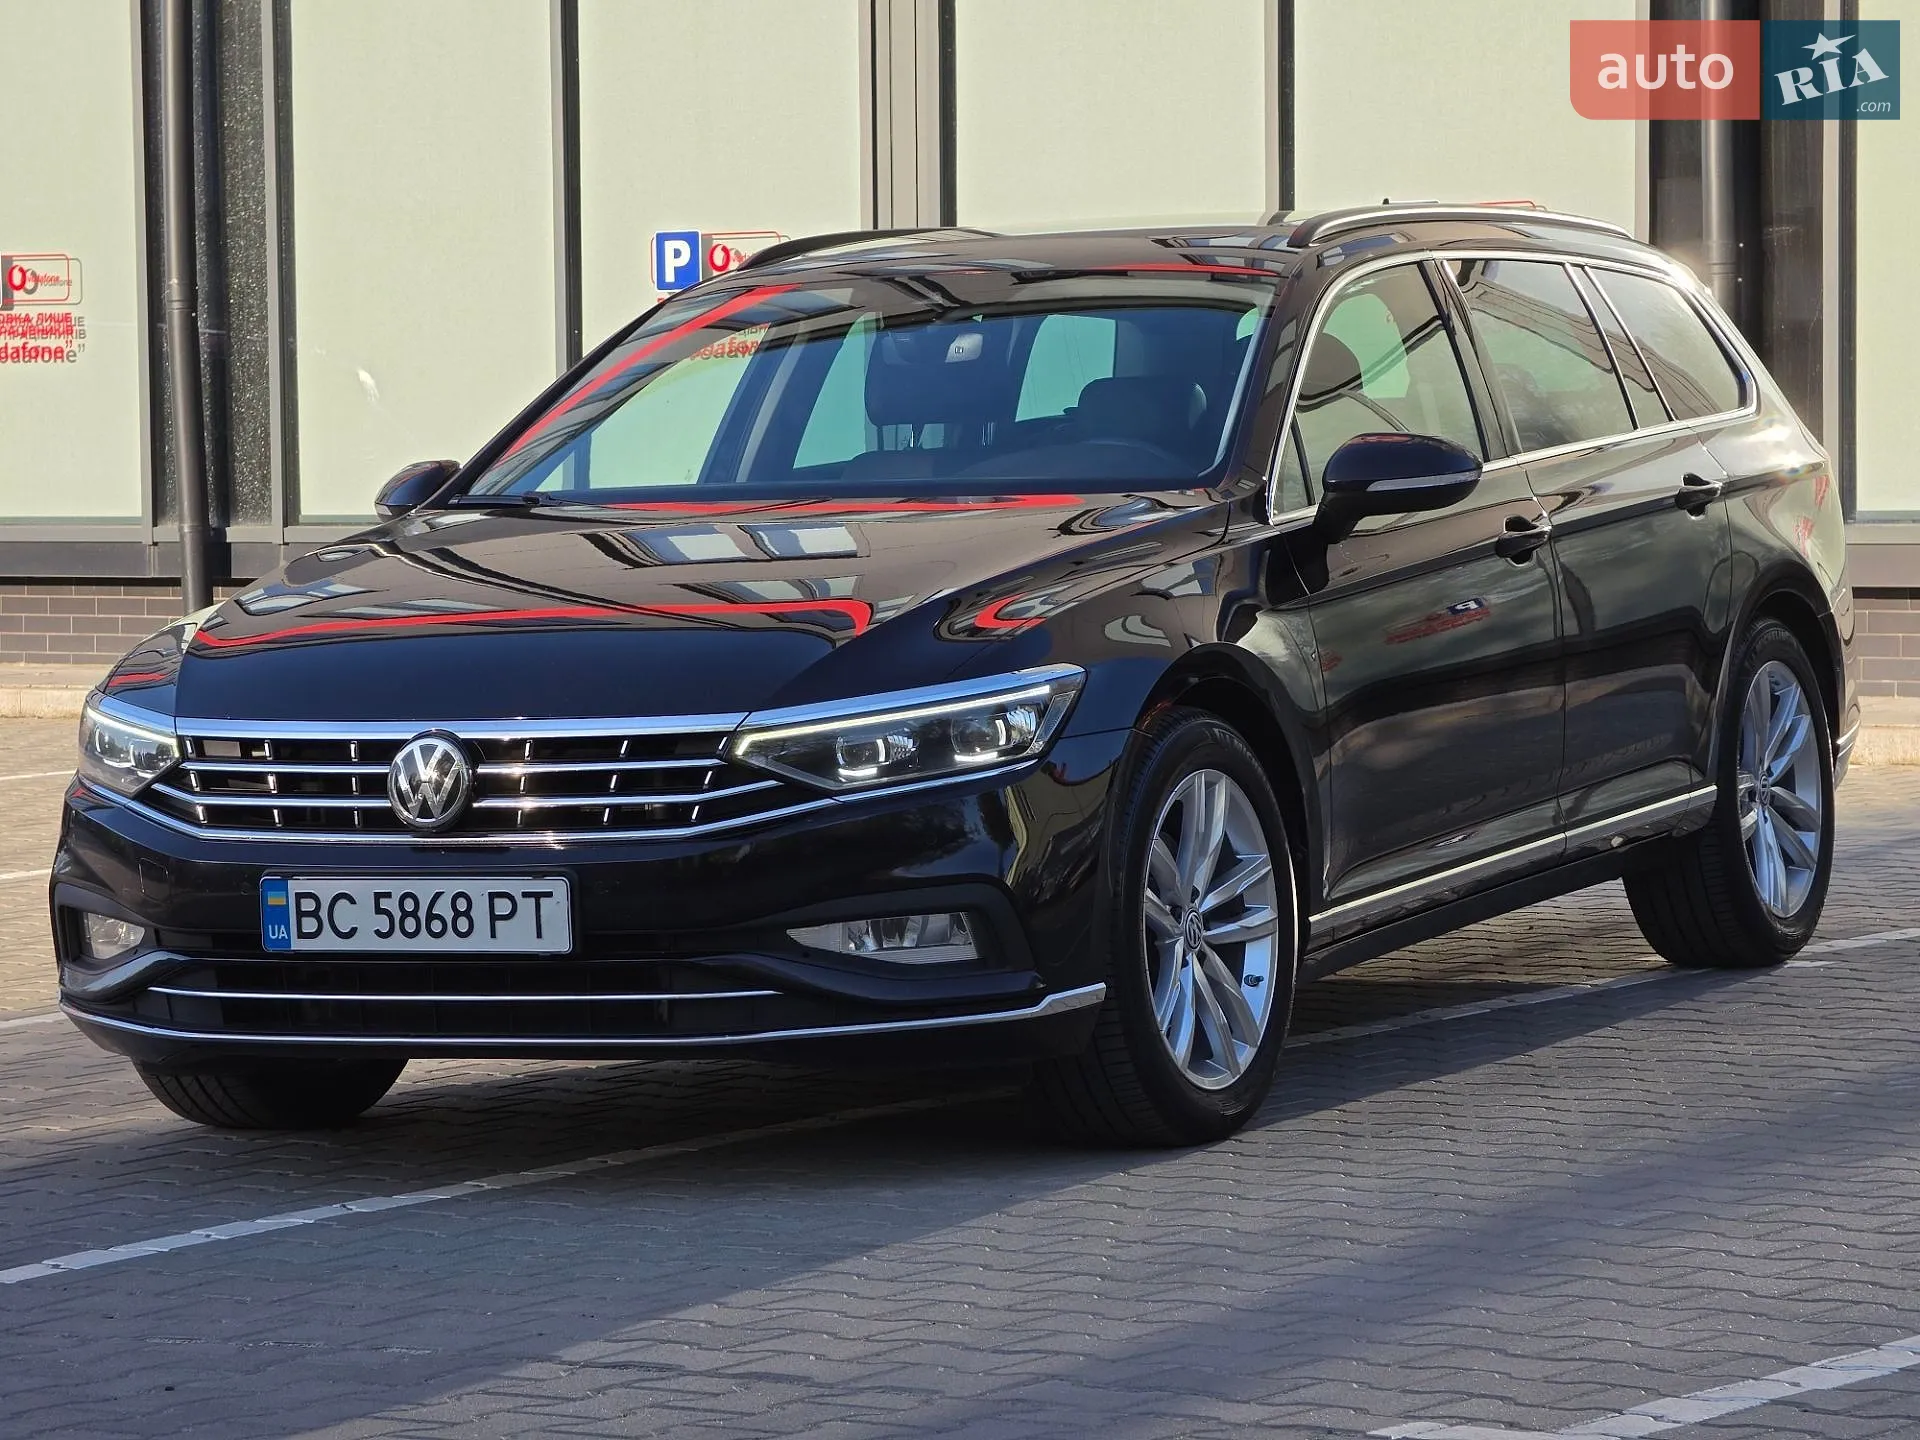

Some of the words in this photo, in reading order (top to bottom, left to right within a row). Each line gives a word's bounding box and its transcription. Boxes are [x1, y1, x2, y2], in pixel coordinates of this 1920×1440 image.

[664, 240, 691, 283] P
[268, 924, 288, 940] UA
[294, 891, 359, 939] BC
[373, 891, 475, 939] 5868
[487, 890, 554, 939] PT
